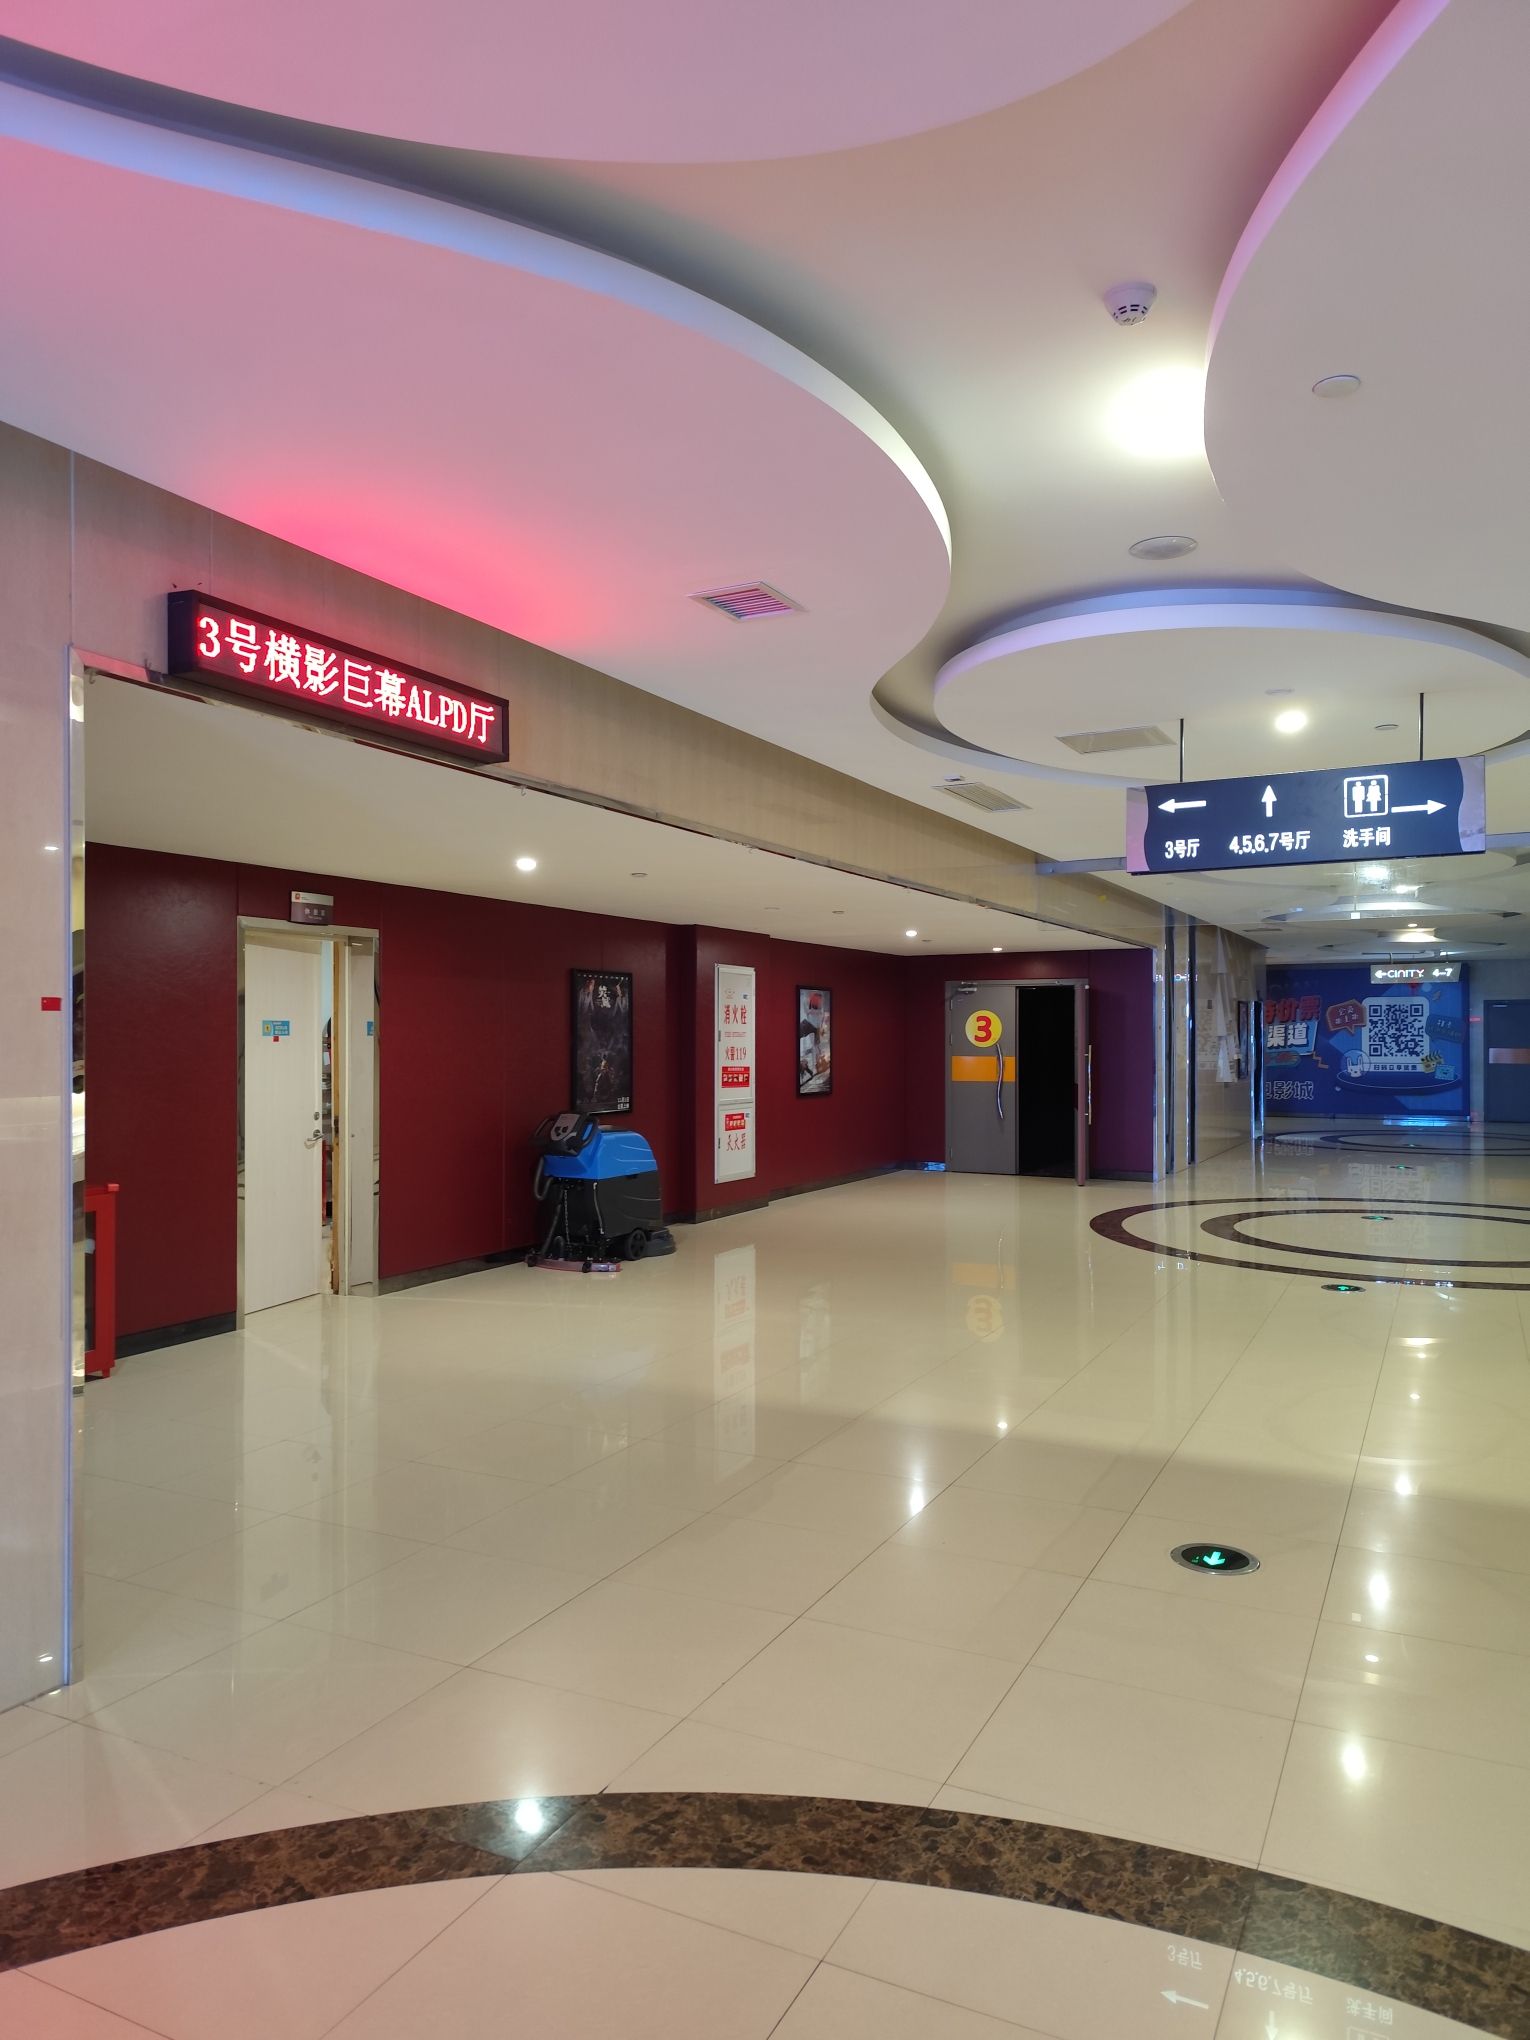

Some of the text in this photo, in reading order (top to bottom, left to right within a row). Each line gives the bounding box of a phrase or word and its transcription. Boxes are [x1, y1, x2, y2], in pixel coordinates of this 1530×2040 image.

[198, 616, 495, 744] 3号横影巨幕ALPD厅
[1164, 838, 1200, 860] 3号厅
[1342, 826, 1392, 849] 洗手间
[1387, 968, 1425, 978] CINITY
[724, 1004, 747, 1025] 消火栓
[975, 1015, 992, 1043] 3
[1267, 1022, 1308, 1047] 渠道
